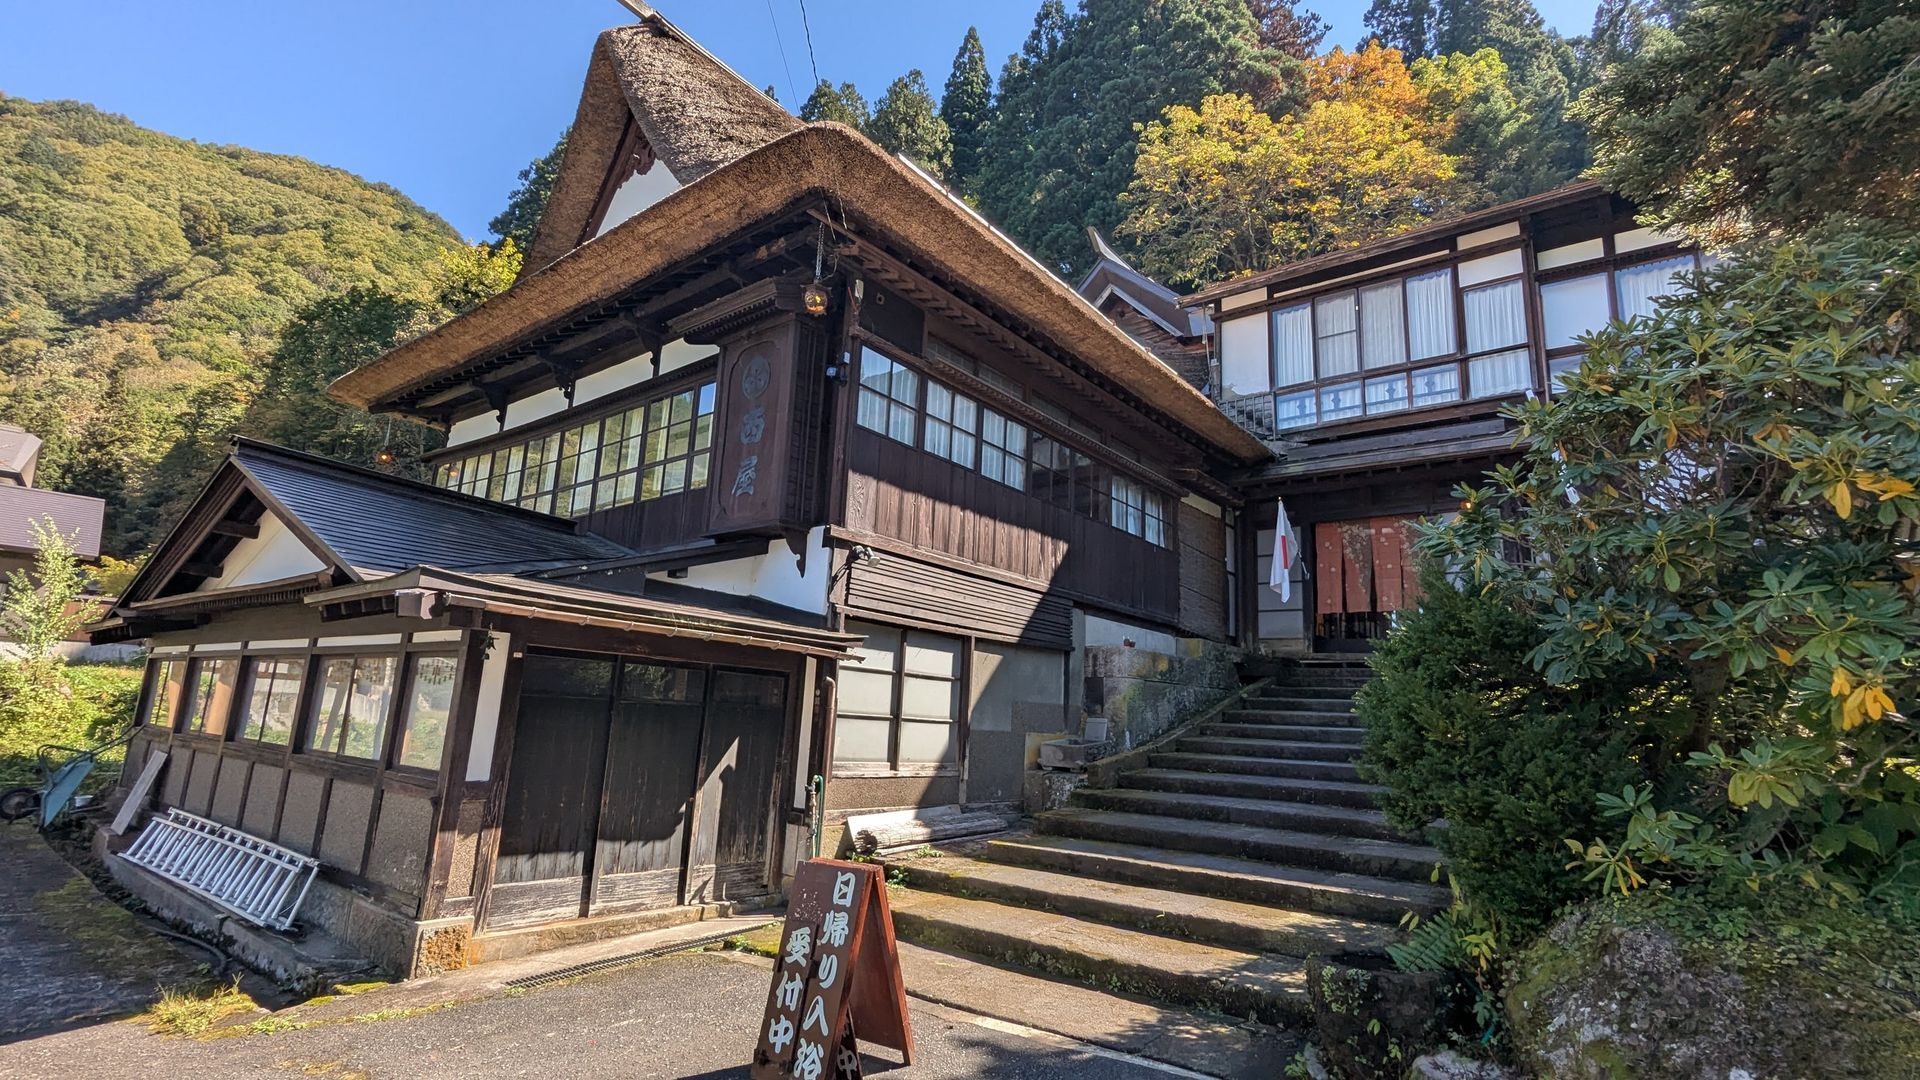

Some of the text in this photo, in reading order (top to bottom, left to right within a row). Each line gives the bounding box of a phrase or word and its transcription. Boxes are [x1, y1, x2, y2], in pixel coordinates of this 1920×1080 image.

[768, 926, 812, 1054] 受付中
[793, 871, 856, 1080] 日帰り入浴
